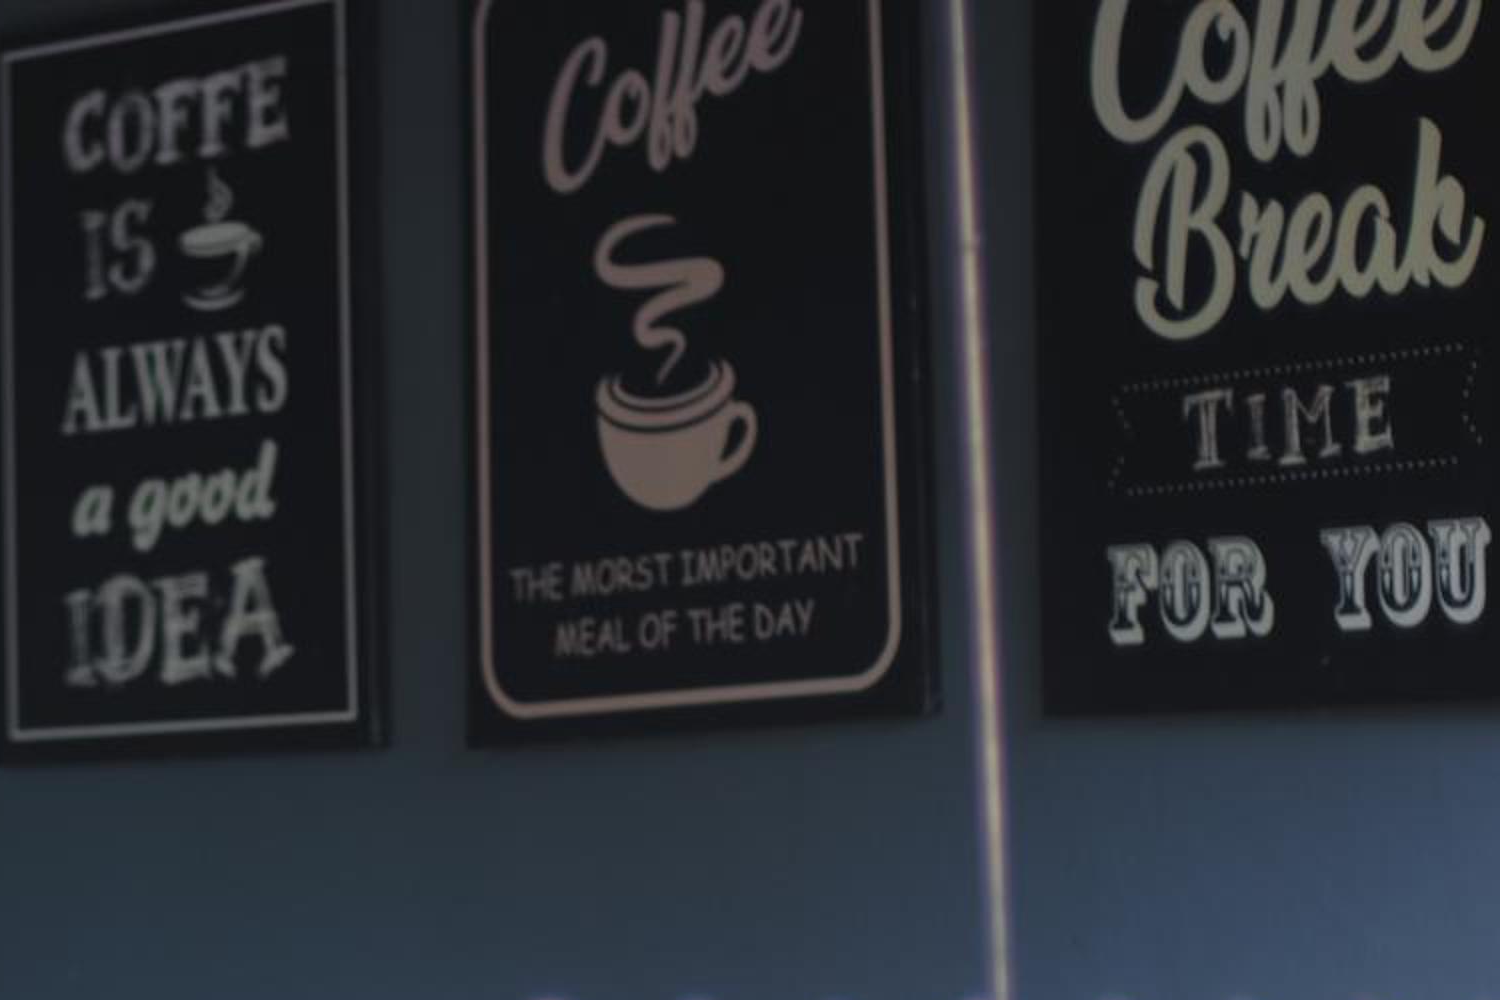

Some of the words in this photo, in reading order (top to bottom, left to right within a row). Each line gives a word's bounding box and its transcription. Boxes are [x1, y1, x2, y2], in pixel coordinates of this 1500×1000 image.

[63, 54, 290, 173] COFFE
[543, 0, 802, 193] Coffee
[1090, 0, 1483, 162] Coffee
[80, 198, 157, 301] IS
[1133, 116, 1486, 340] Break
[62, 323, 292, 435] ALWAYS
[1183, 375, 1394, 471] TIME
[70, 485, 115, 538] a
[127, 439, 278, 552] good
[65, 556, 296, 687] IDEA
[510, 562, 563, 601] THE
[568, 551, 675, 596] MORST
[680, 532, 864, 586] IMPORTANT
[1106, 534, 1276, 645] FOR
[1319, 517, 1492, 632] YOU
[553, 616, 632, 656] MEAL
[637, 608, 678, 650] OF
[687, 602, 745, 645] THE
[753, 599, 816, 640] DAY
